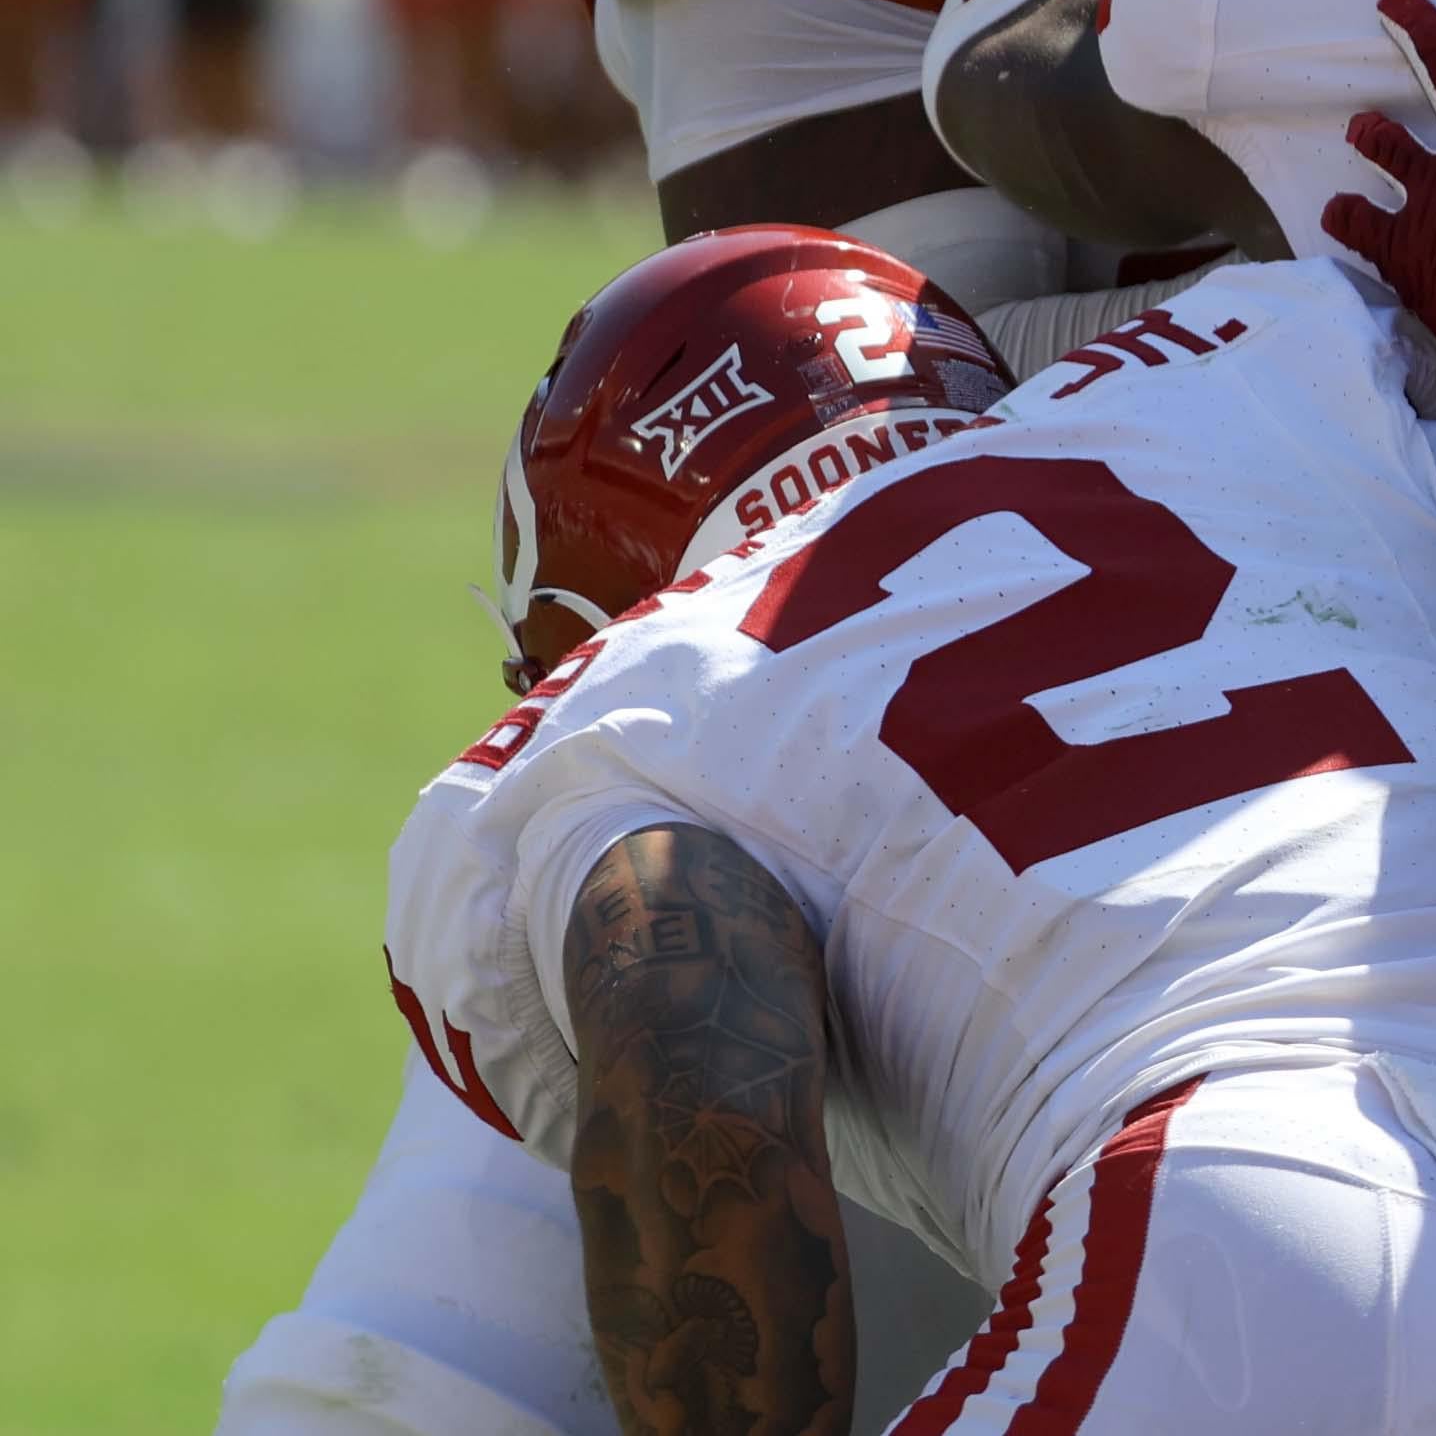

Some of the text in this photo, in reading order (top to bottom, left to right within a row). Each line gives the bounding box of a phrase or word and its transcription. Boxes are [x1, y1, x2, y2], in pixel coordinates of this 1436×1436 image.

[815, 294, 916, 385] 2
[1050, 308, 1248, 400] JR.
[737, 454, 1417, 876] 2
